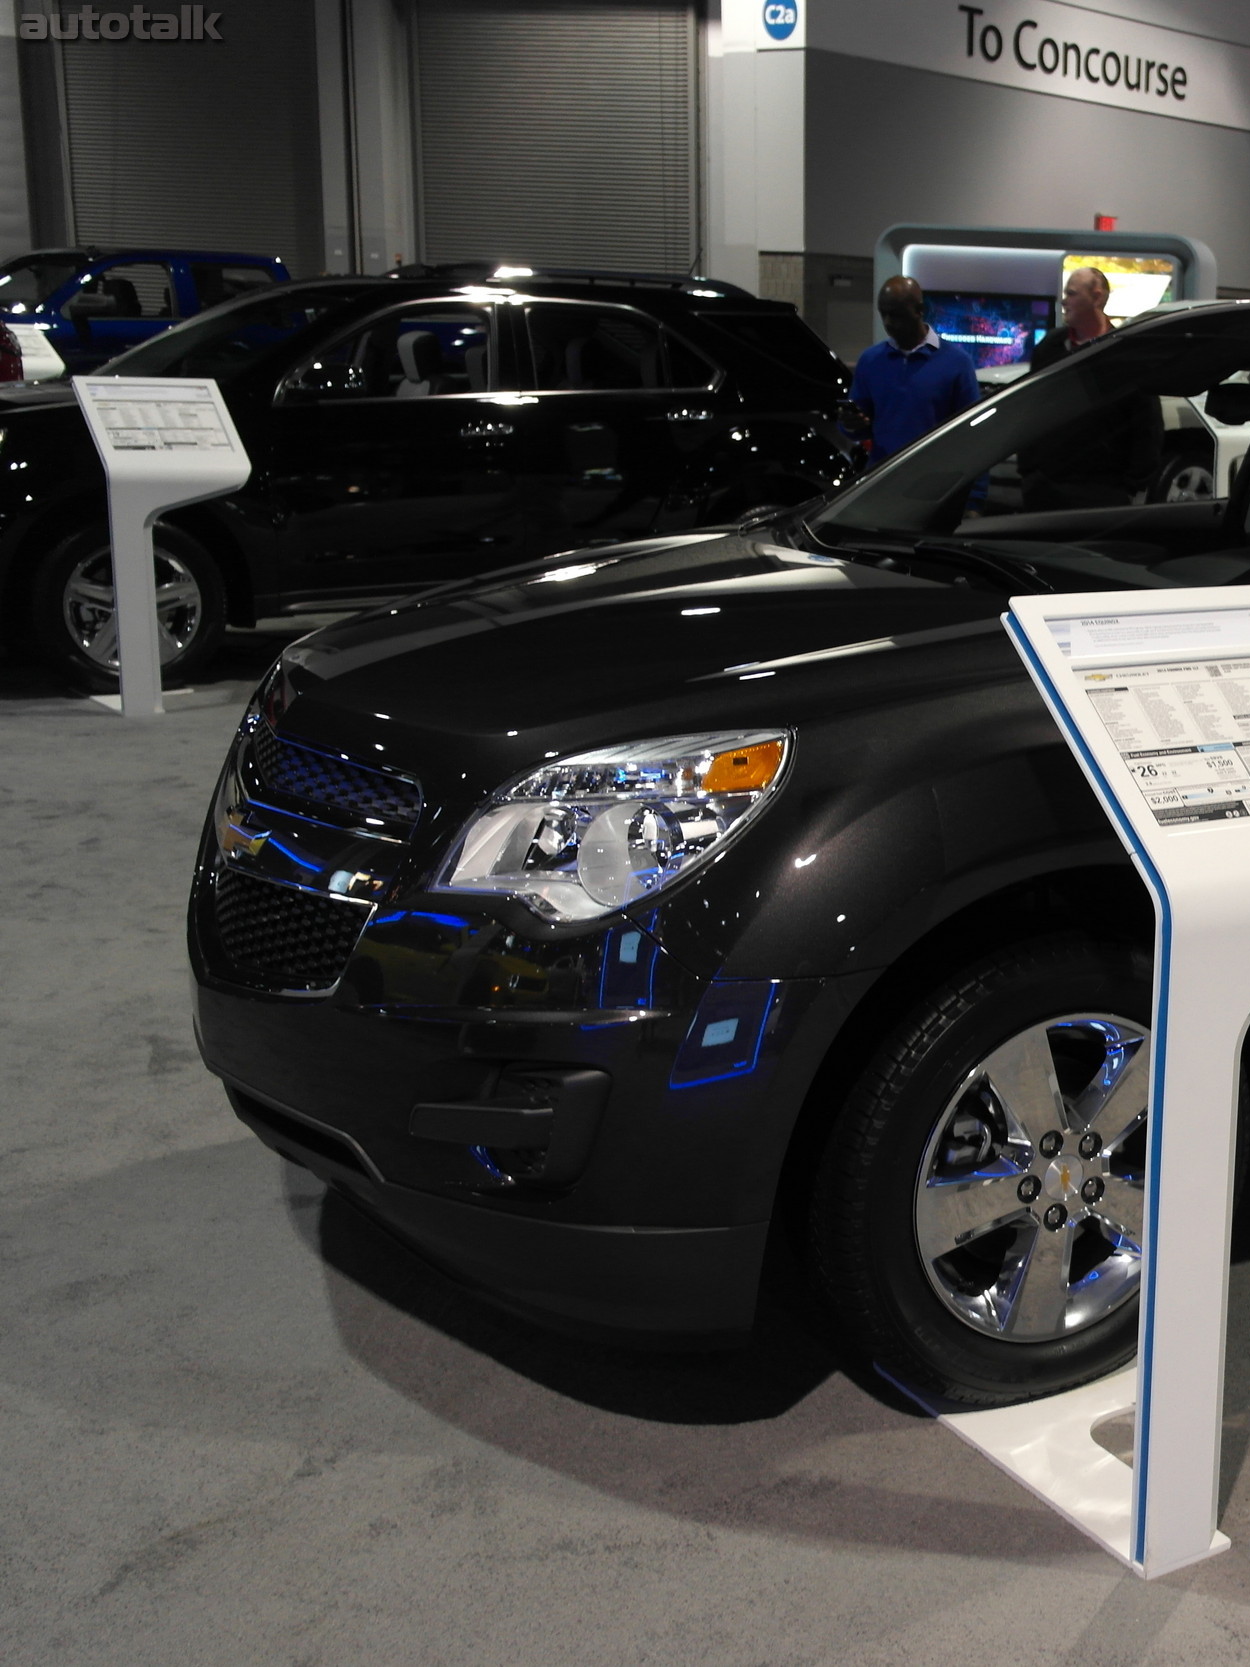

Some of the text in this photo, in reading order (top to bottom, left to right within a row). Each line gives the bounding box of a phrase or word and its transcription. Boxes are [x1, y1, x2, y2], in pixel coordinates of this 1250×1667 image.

[765, 4, 795, 25] C2a
[957, 5, 1187, 100] To Concourse
[1137, 764, 1158, 777] 26
[1206, 760, 1233, 768] $1,500
[1151, 795, 1178, 804] $2,000
